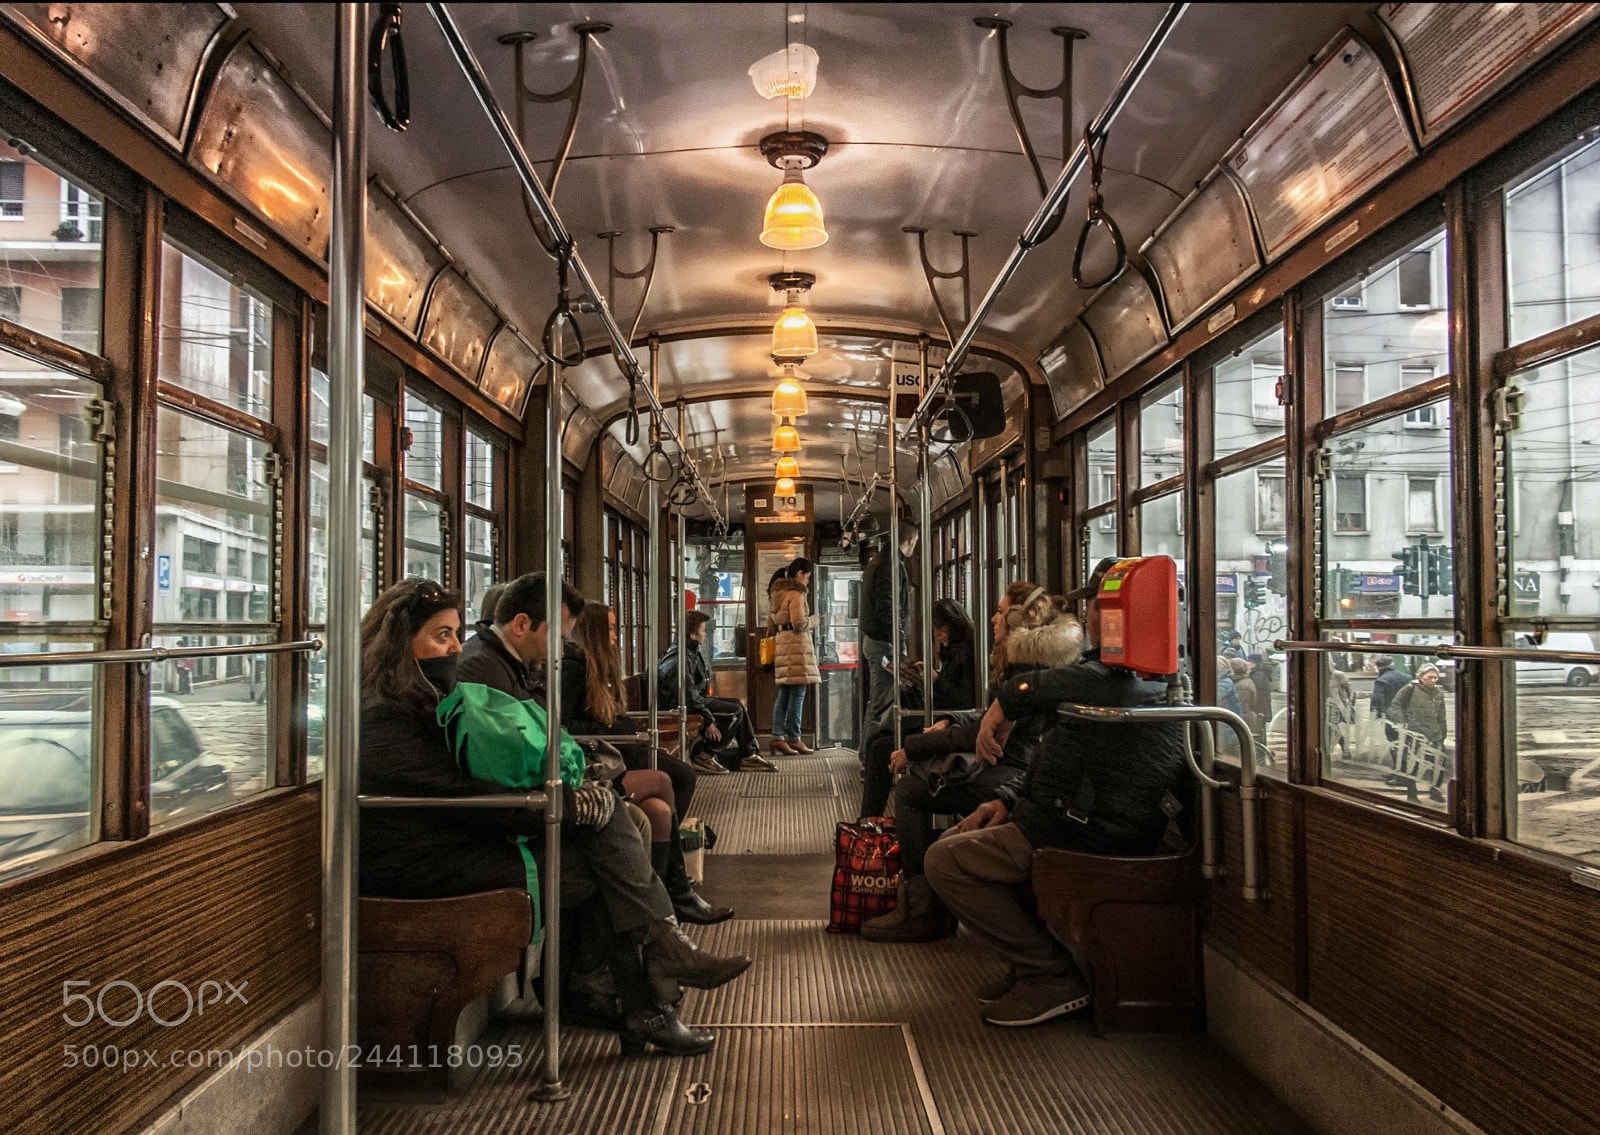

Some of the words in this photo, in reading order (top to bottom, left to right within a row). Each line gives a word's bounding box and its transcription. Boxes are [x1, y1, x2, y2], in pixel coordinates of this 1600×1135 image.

[780, 496, 797, 508] 19
[159, 556, 169, 577] P
[851, 886, 873, 895] JOHN
